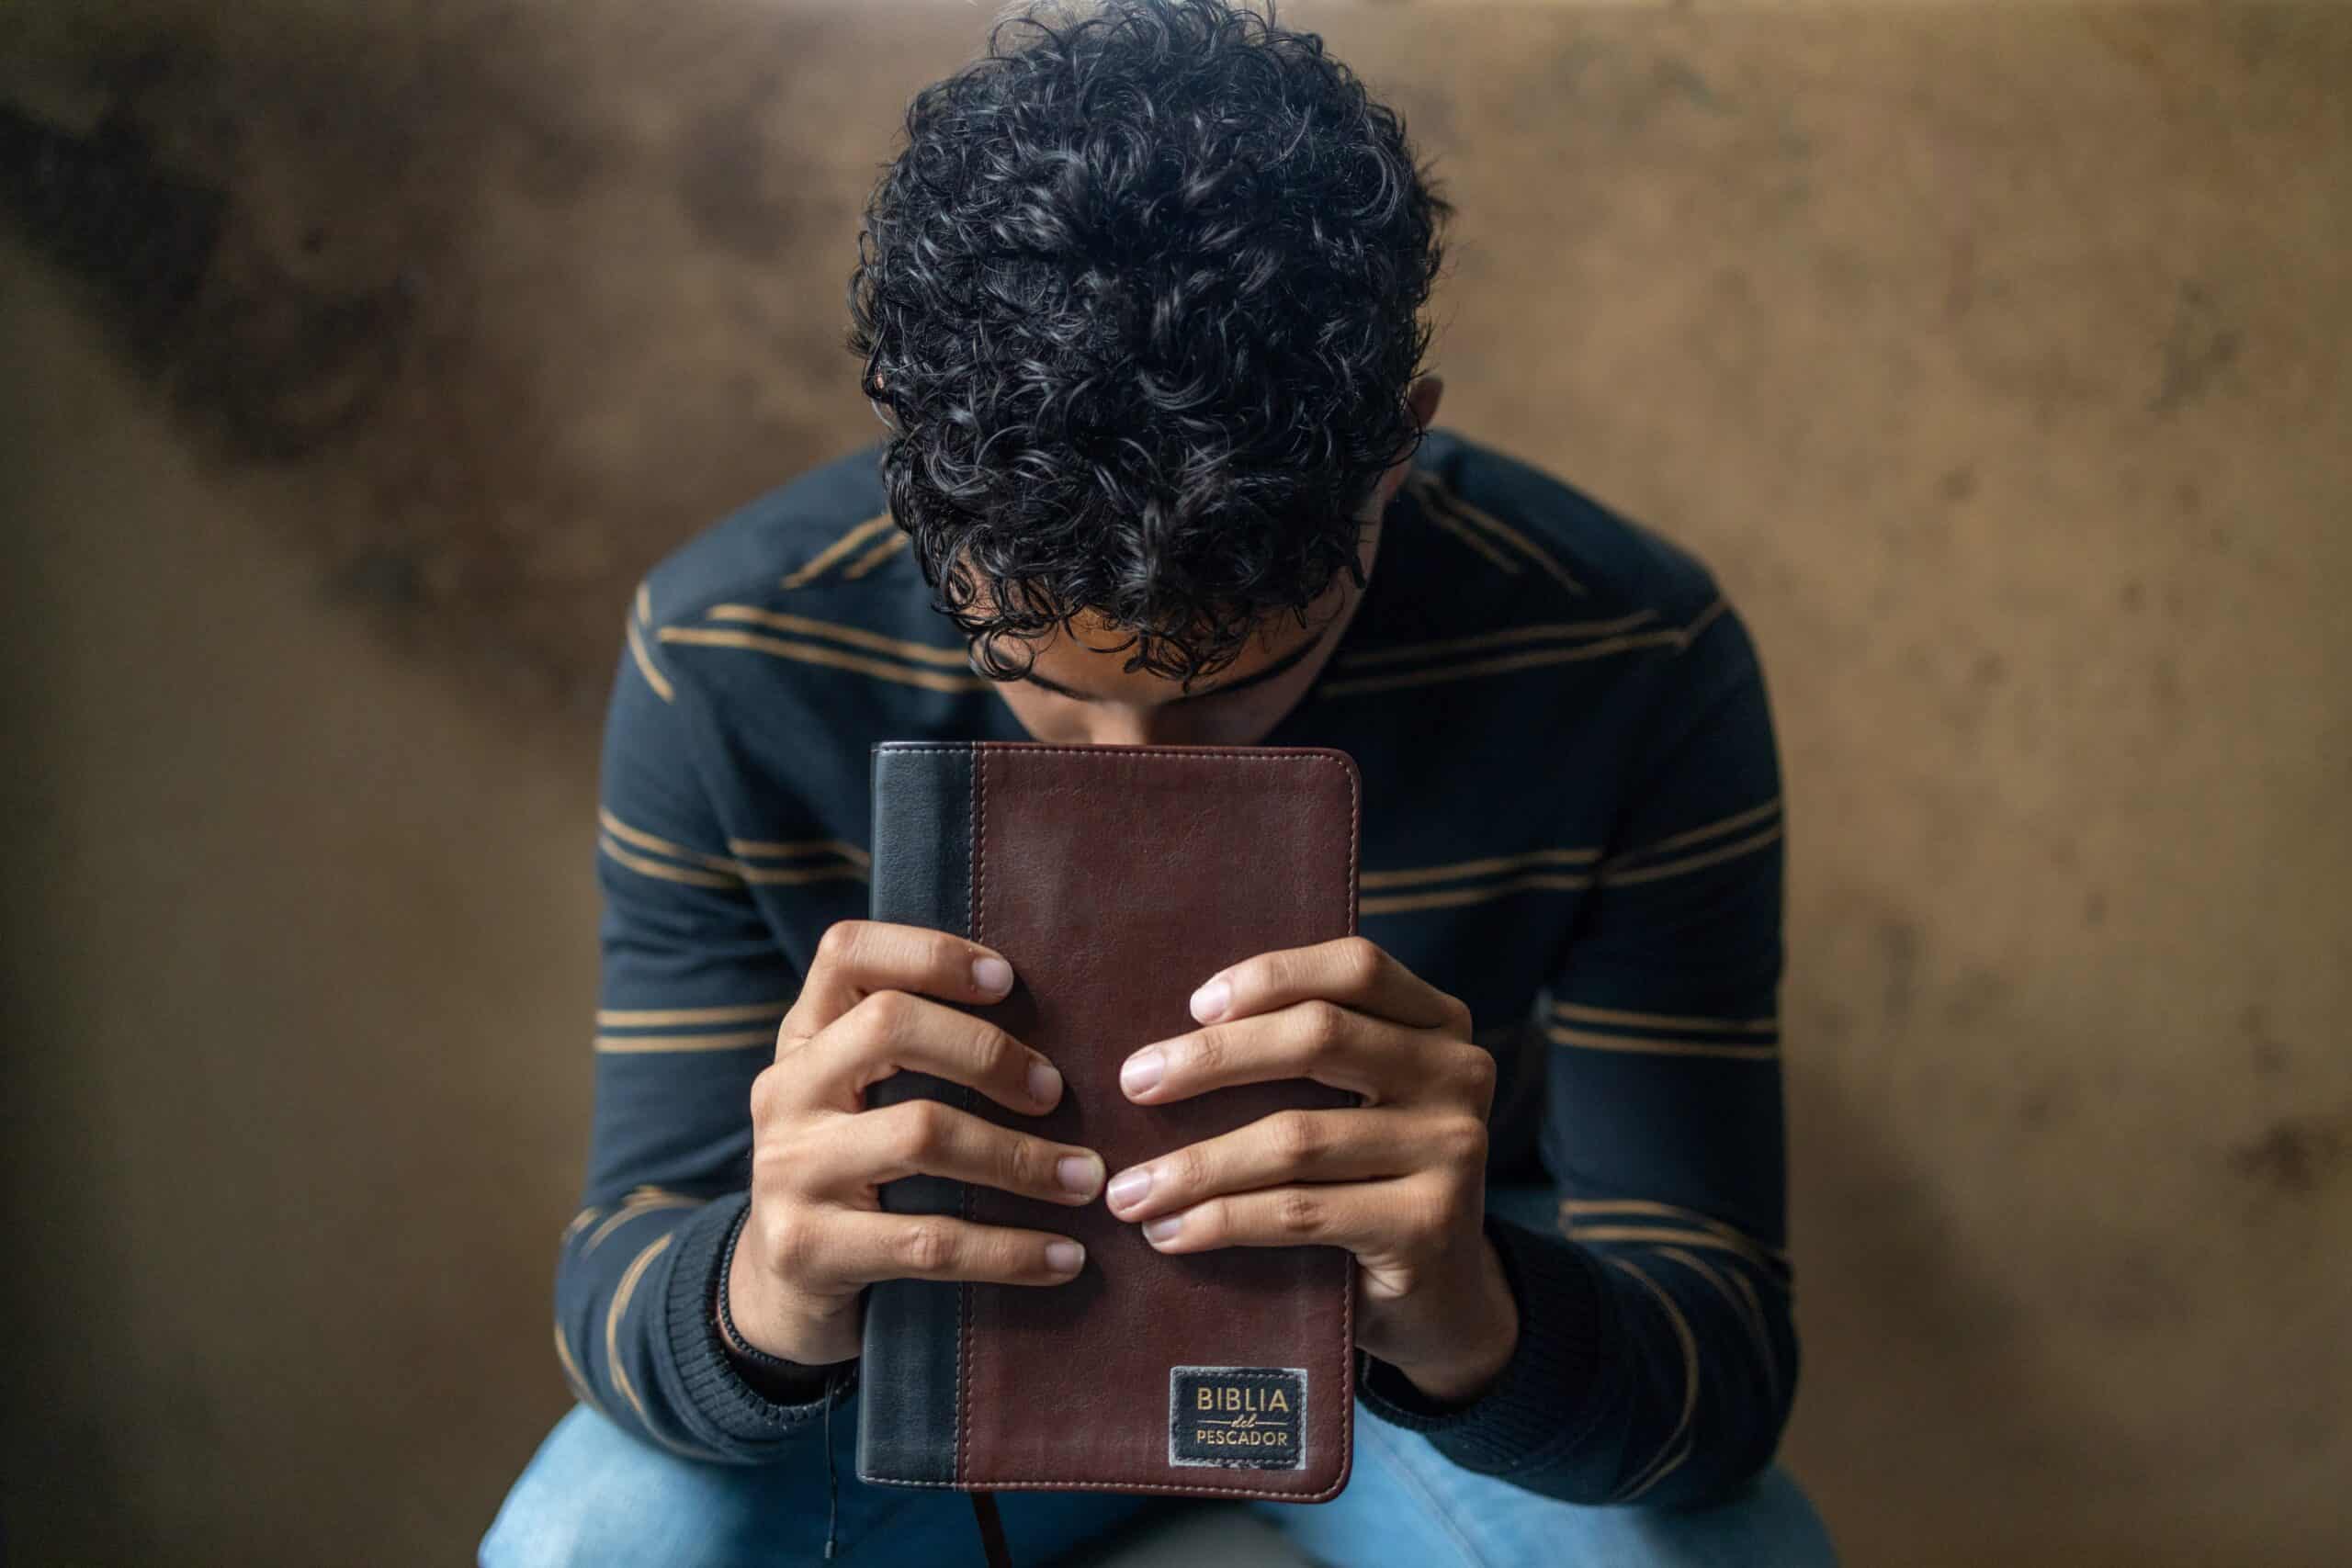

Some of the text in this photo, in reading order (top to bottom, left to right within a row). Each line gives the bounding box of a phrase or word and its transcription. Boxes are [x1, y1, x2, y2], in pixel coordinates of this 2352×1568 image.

[1197, 1387, 1289, 1412] BIBLIA
[1231, 1414, 1257, 1427] del
[1197, 1430, 1287, 1446] PESCADOR
